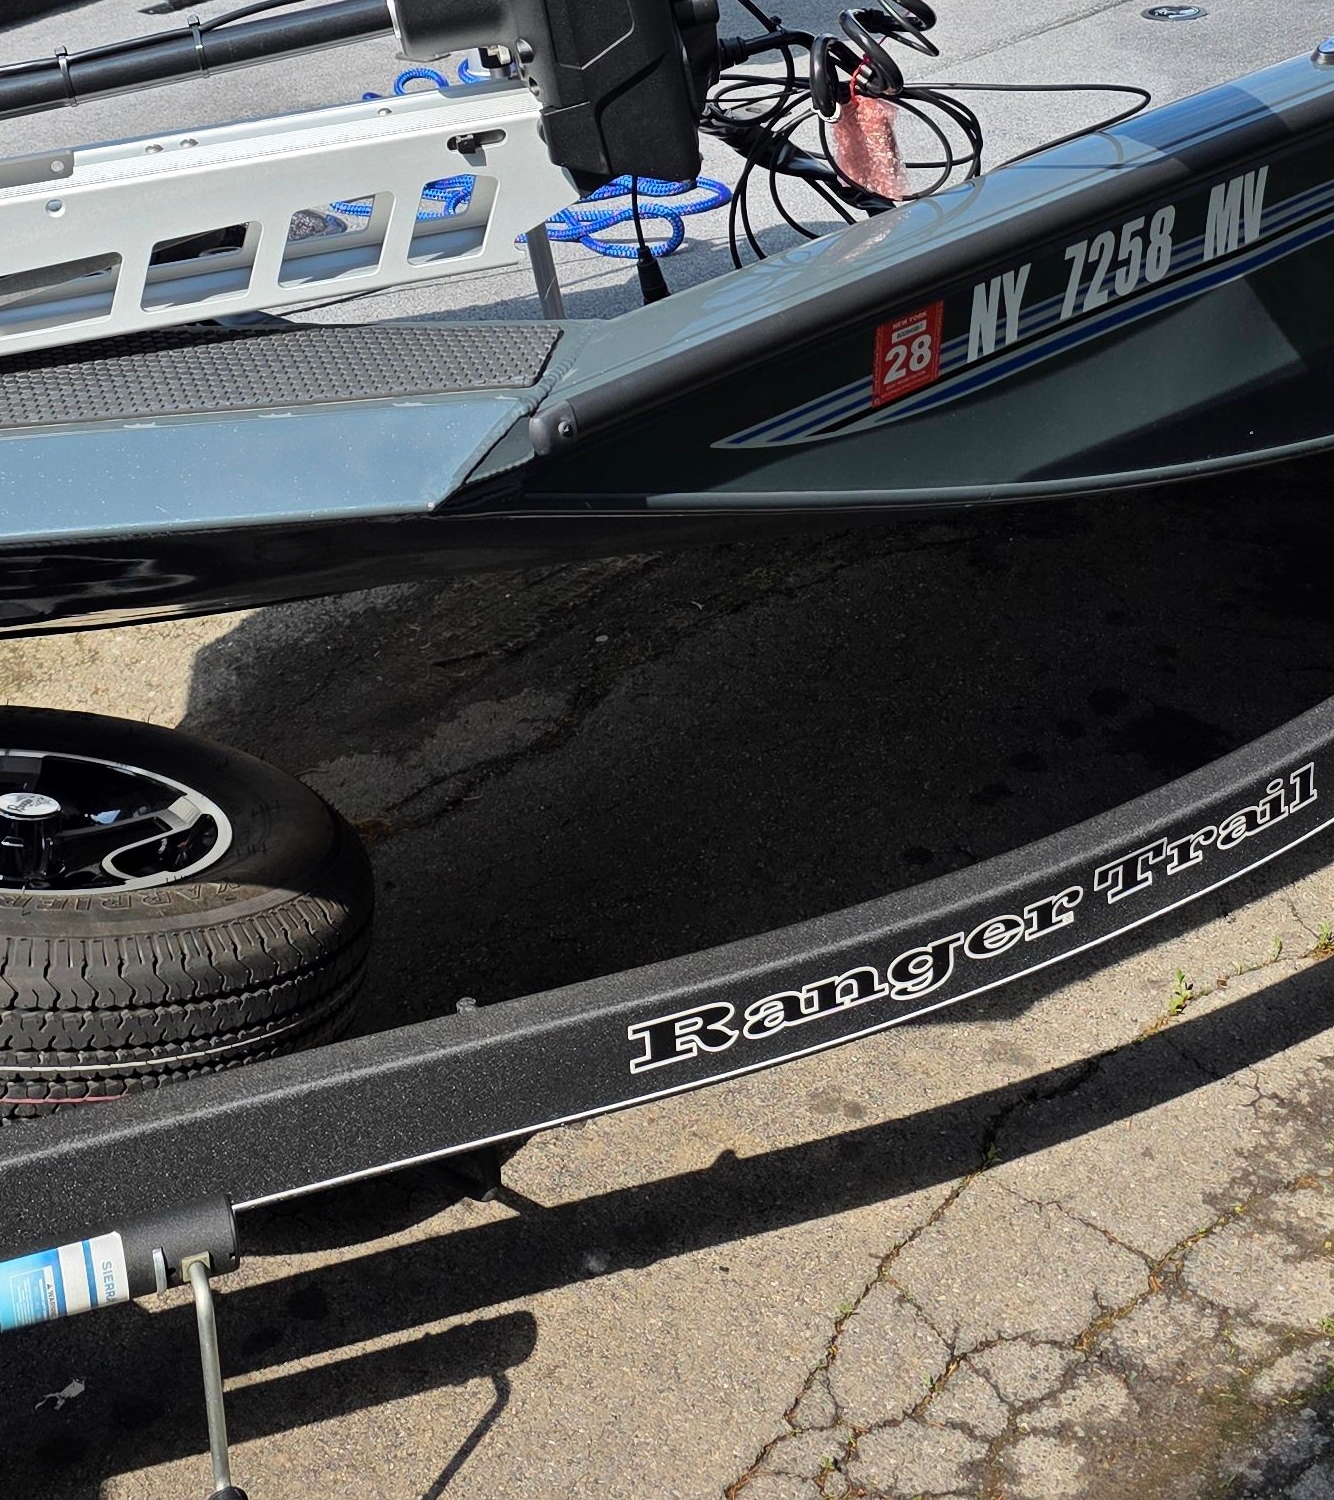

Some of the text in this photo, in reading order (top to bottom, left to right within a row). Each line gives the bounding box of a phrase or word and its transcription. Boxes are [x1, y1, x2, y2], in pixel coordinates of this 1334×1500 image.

[908, 309, 928, 323] YORK
[966, 165, 1269, 364] NY 7258 MV
[883, 333, 932, 385] 28
[627, 761, 1318, 1075] Ranger Trail
